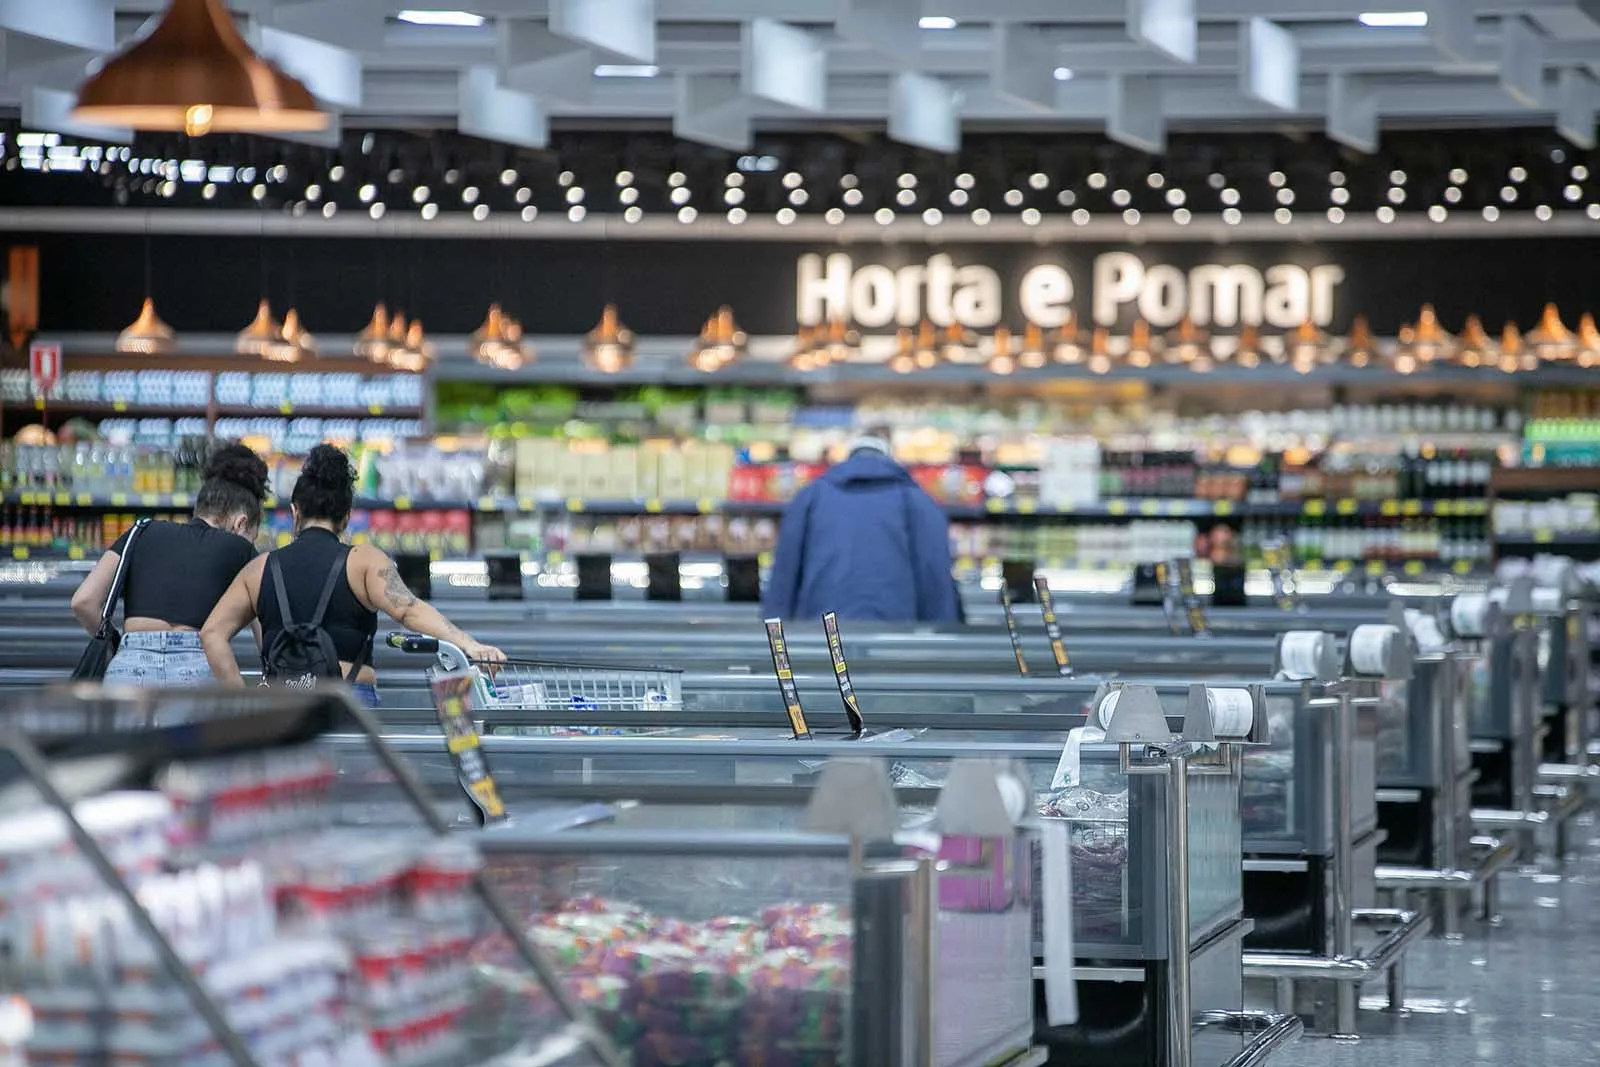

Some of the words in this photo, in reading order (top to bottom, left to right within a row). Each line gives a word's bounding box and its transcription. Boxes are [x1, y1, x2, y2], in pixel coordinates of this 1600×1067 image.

[797, 252, 1001, 327] Horta
[1020, 264, 1074, 327] e
[1093, 251, 1344, 327] Pomar
